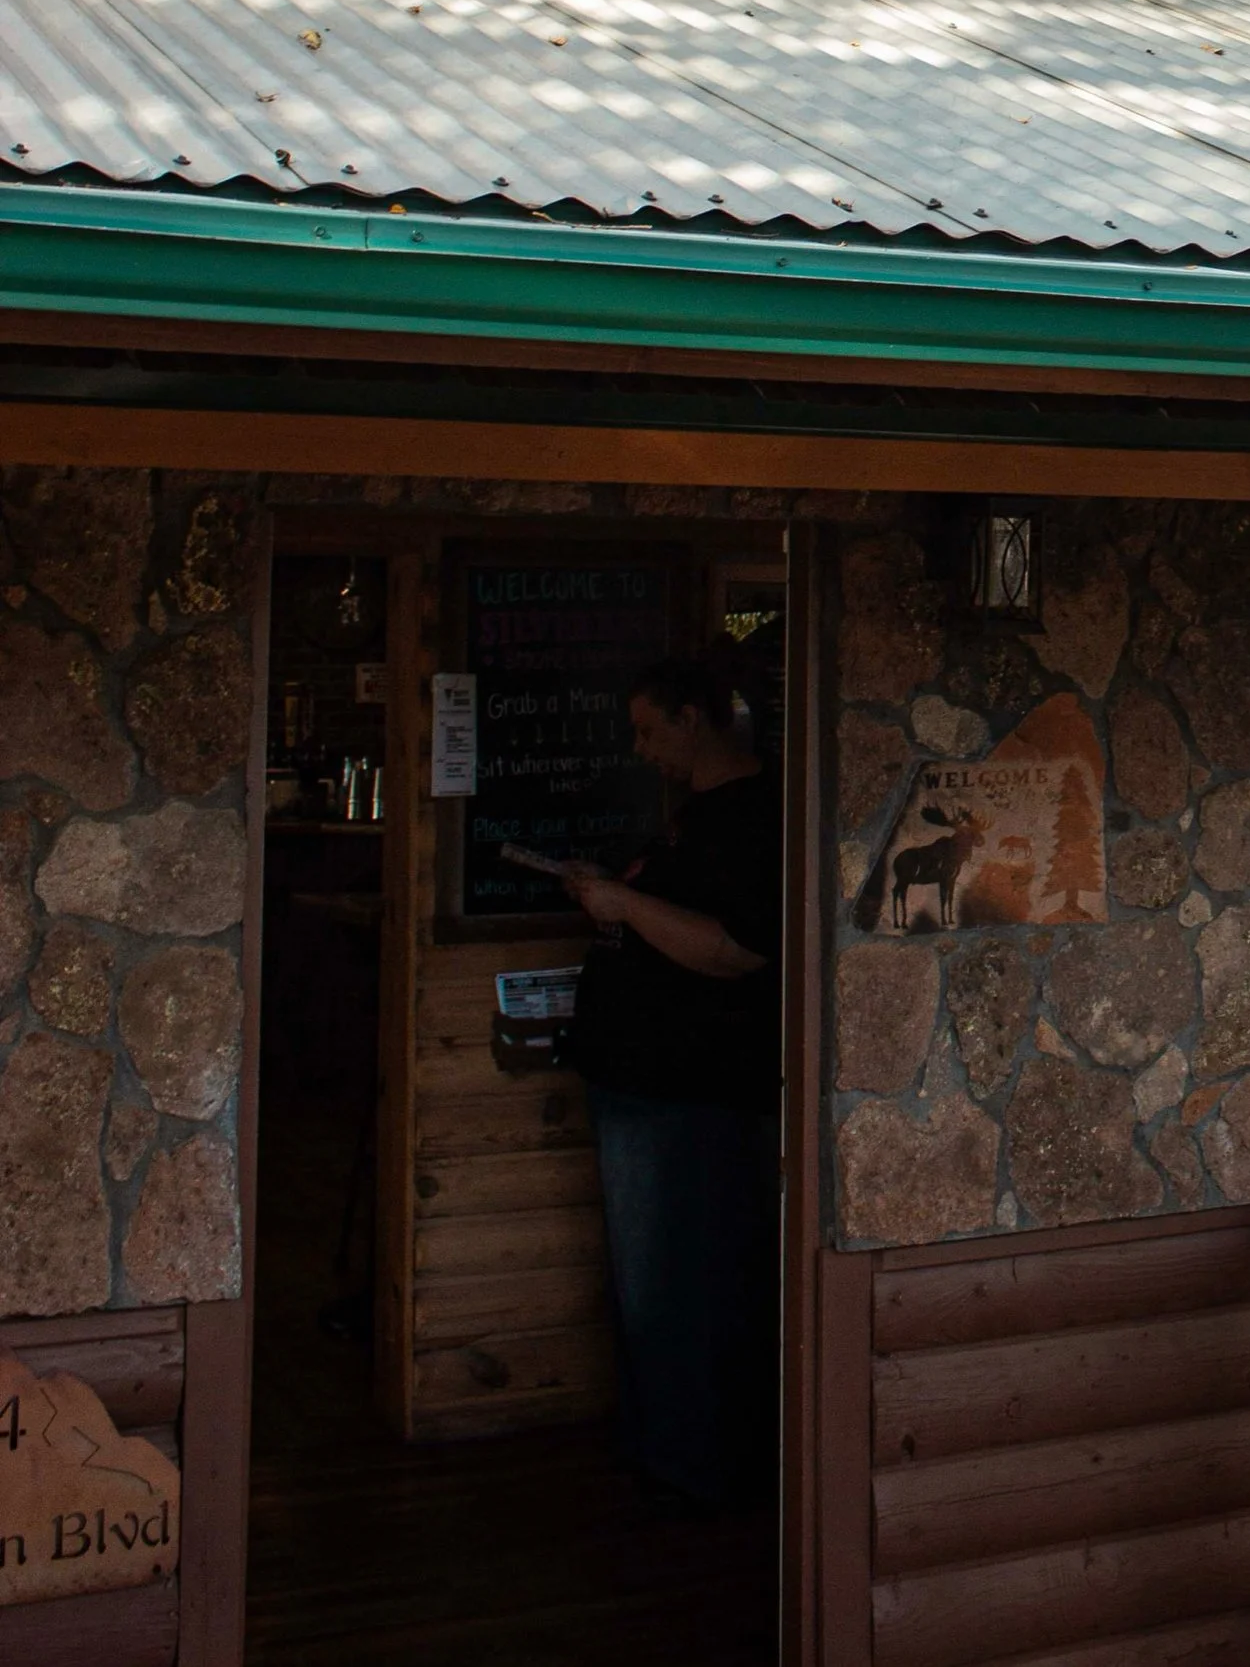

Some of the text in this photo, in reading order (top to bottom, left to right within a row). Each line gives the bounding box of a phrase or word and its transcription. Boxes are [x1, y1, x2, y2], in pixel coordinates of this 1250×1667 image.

[476, 570, 647, 606] WELCOME TO
[487, 691, 538, 720] Grab
[546, 695, 558, 713] a
[923, 767, 1048, 791] WELCOME
[473, 814, 521, 839] Place
[51, 1500, 169, 1560] Blvd
